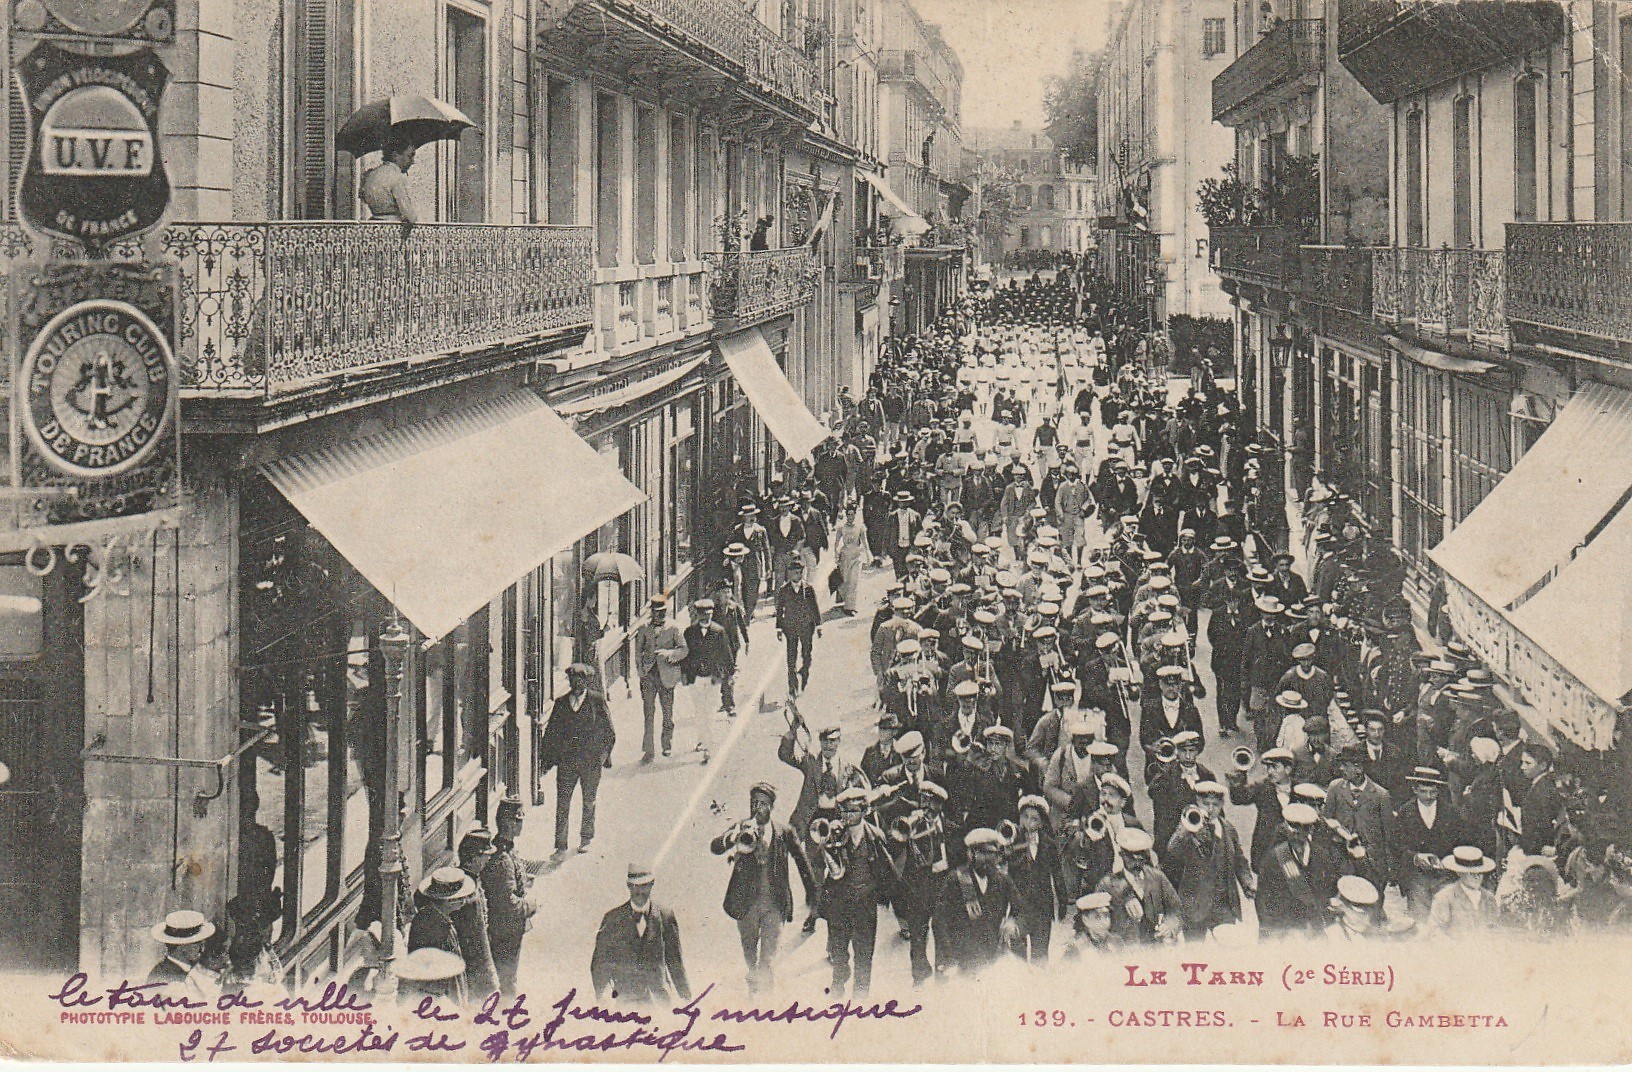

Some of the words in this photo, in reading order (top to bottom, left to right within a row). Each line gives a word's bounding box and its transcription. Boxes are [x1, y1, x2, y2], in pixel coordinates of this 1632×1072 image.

[31, 313, 120, 394] TOURING
[125, 323, 168, 384] CLUB
[40, 418, 73, 455] DE
[73, 413, 158, 467] FRANCE
[48, 972, 103, 1008] le
[216, 990, 264, 1011] de
[275, 977, 374, 1012] ville
[415, 996, 460, 1022] le
[711, 987, 923, 1040] musique
[404, 1030, 467, 1051] de
